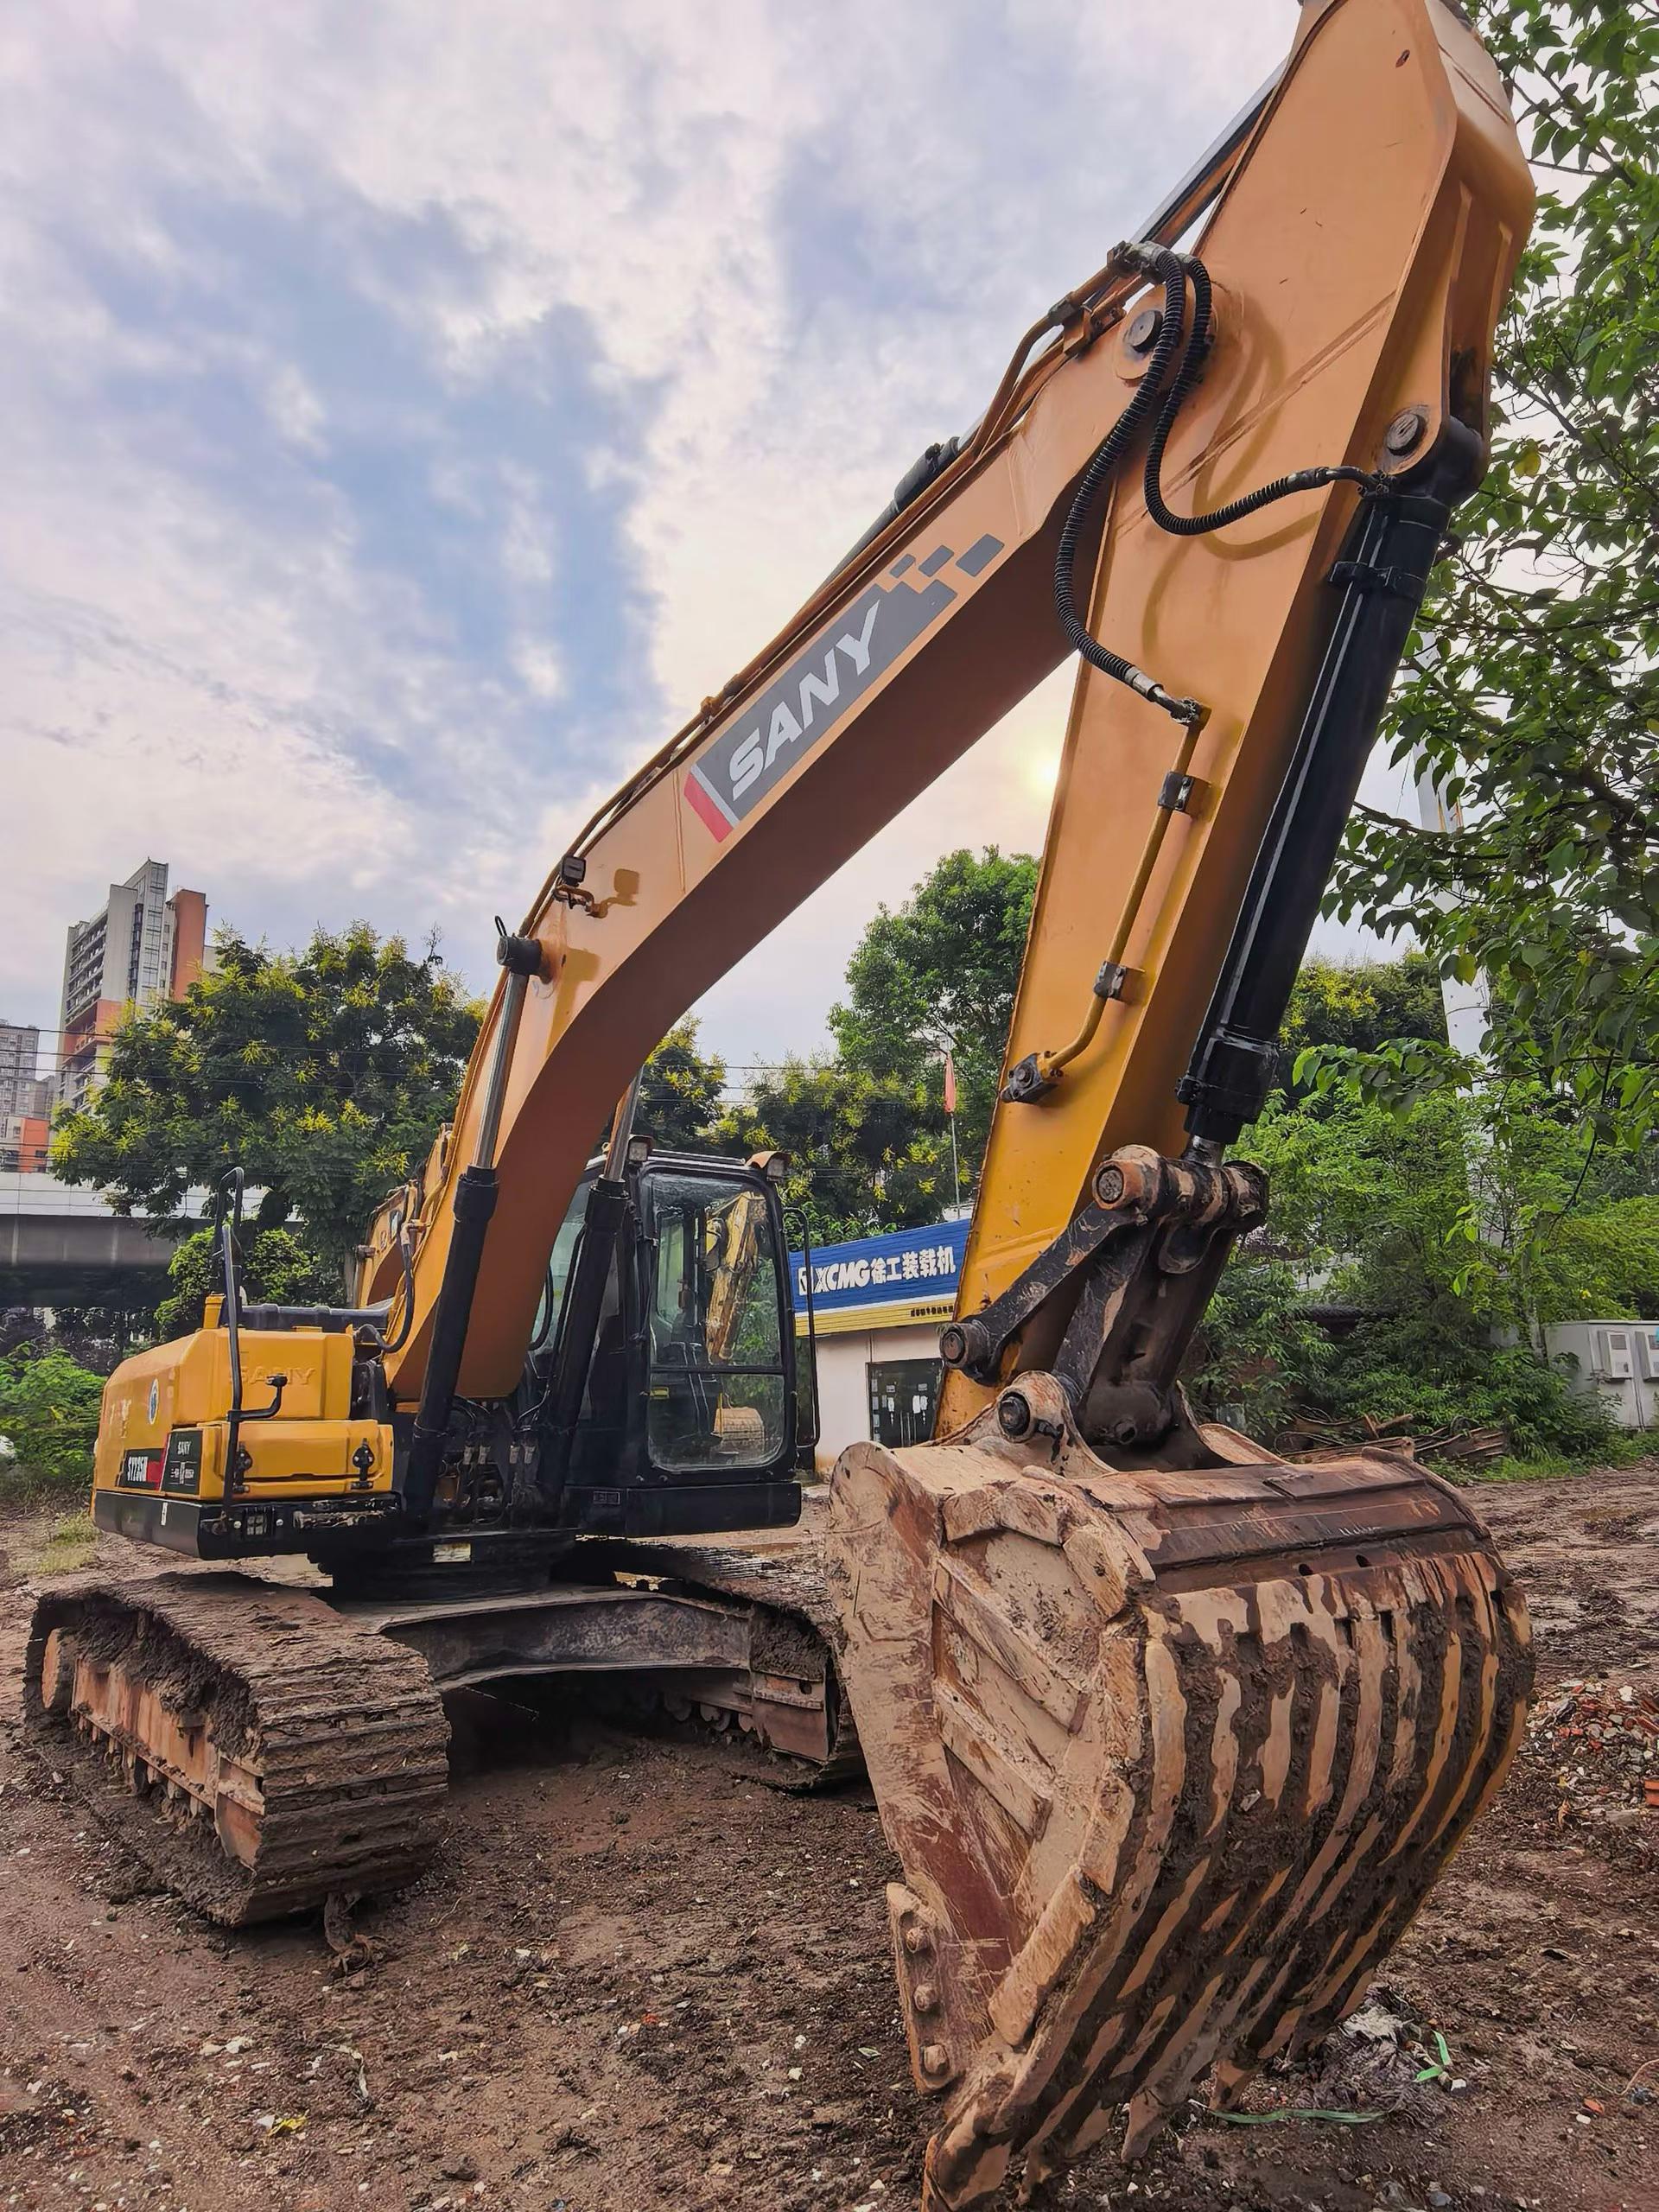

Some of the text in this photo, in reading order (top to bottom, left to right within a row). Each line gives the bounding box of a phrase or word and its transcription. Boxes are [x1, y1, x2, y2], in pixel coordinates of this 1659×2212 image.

[728, 599, 880, 801] SANY
[814, 1245, 957, 1294] XCMG 徐工装载机
